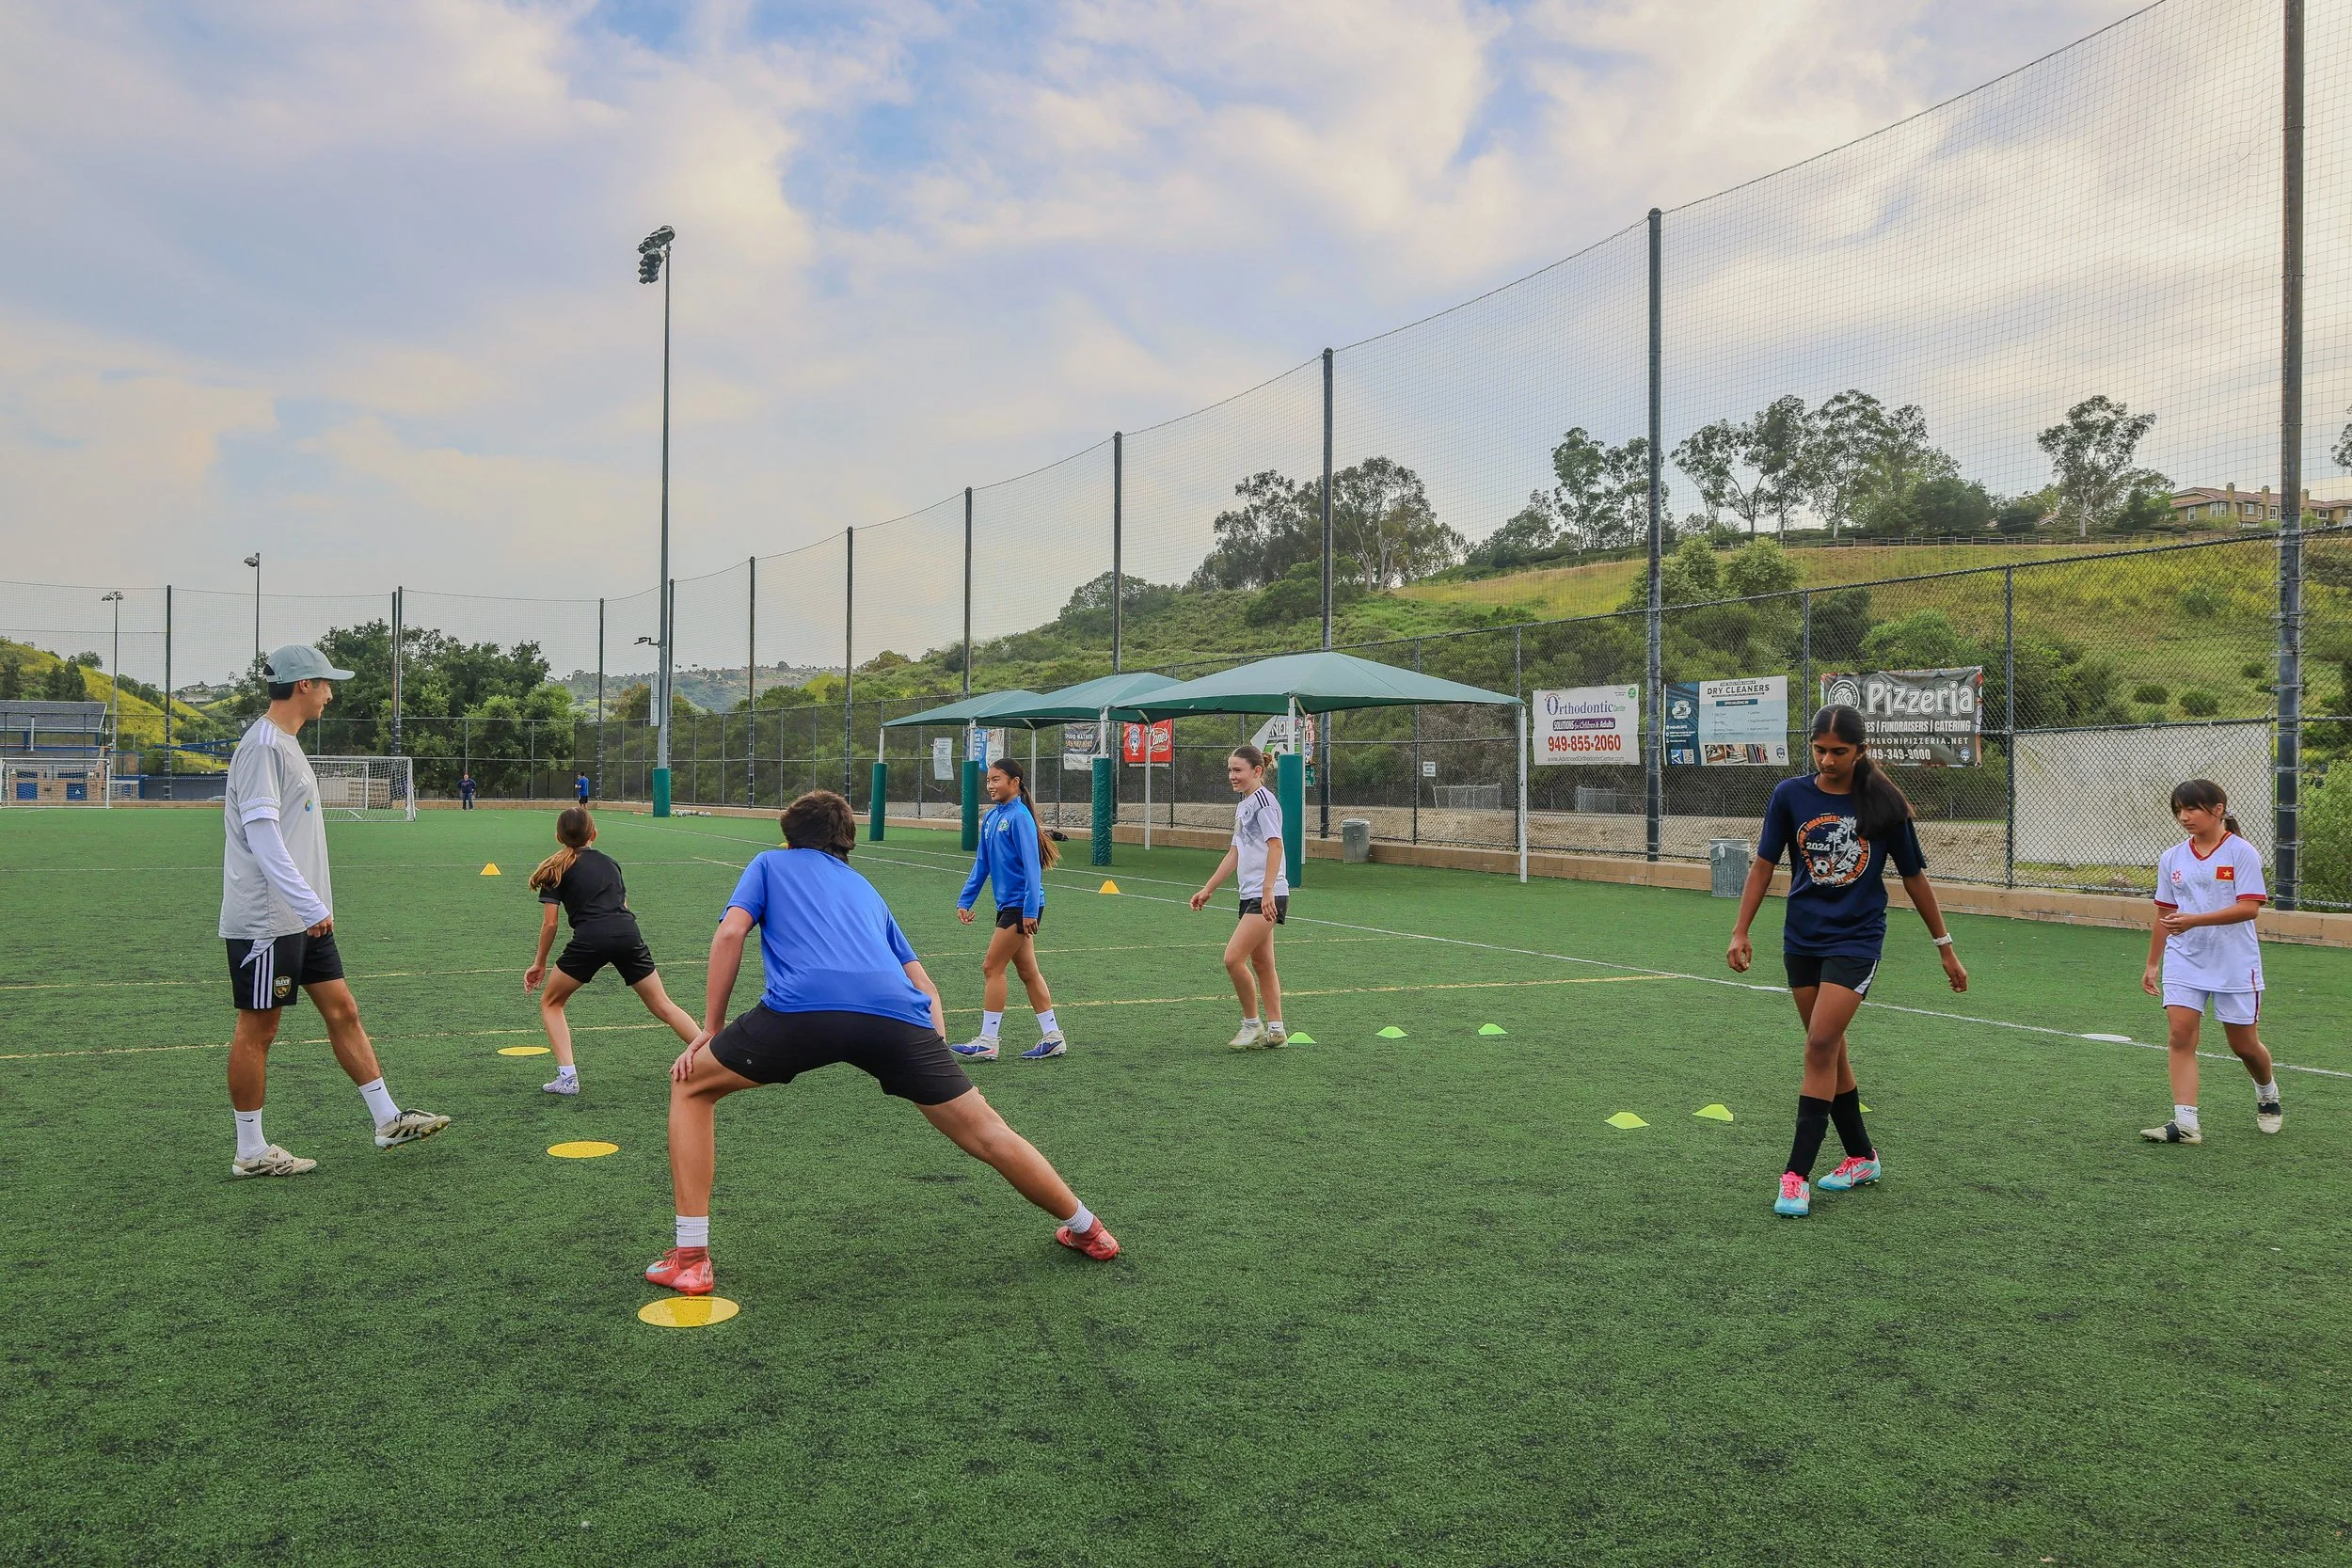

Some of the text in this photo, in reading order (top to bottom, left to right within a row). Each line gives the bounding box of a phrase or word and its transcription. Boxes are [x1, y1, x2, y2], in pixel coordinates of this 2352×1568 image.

[1708, 687, 1724, 695] DRY
[1725, 684, 1770, 694] CLEANERS
[1867, 680, 1975, 717] Pizzeria
[1547, 695, 1613, 715] Orthodontic
[1553, 721, 1574, 730] SOLUTIONS
[1881, 721, 1929, 733] FUNDRAISERS
[1934, 720, 1971, 733] CATERING
[1806, 842, 1831, 851] 2024
